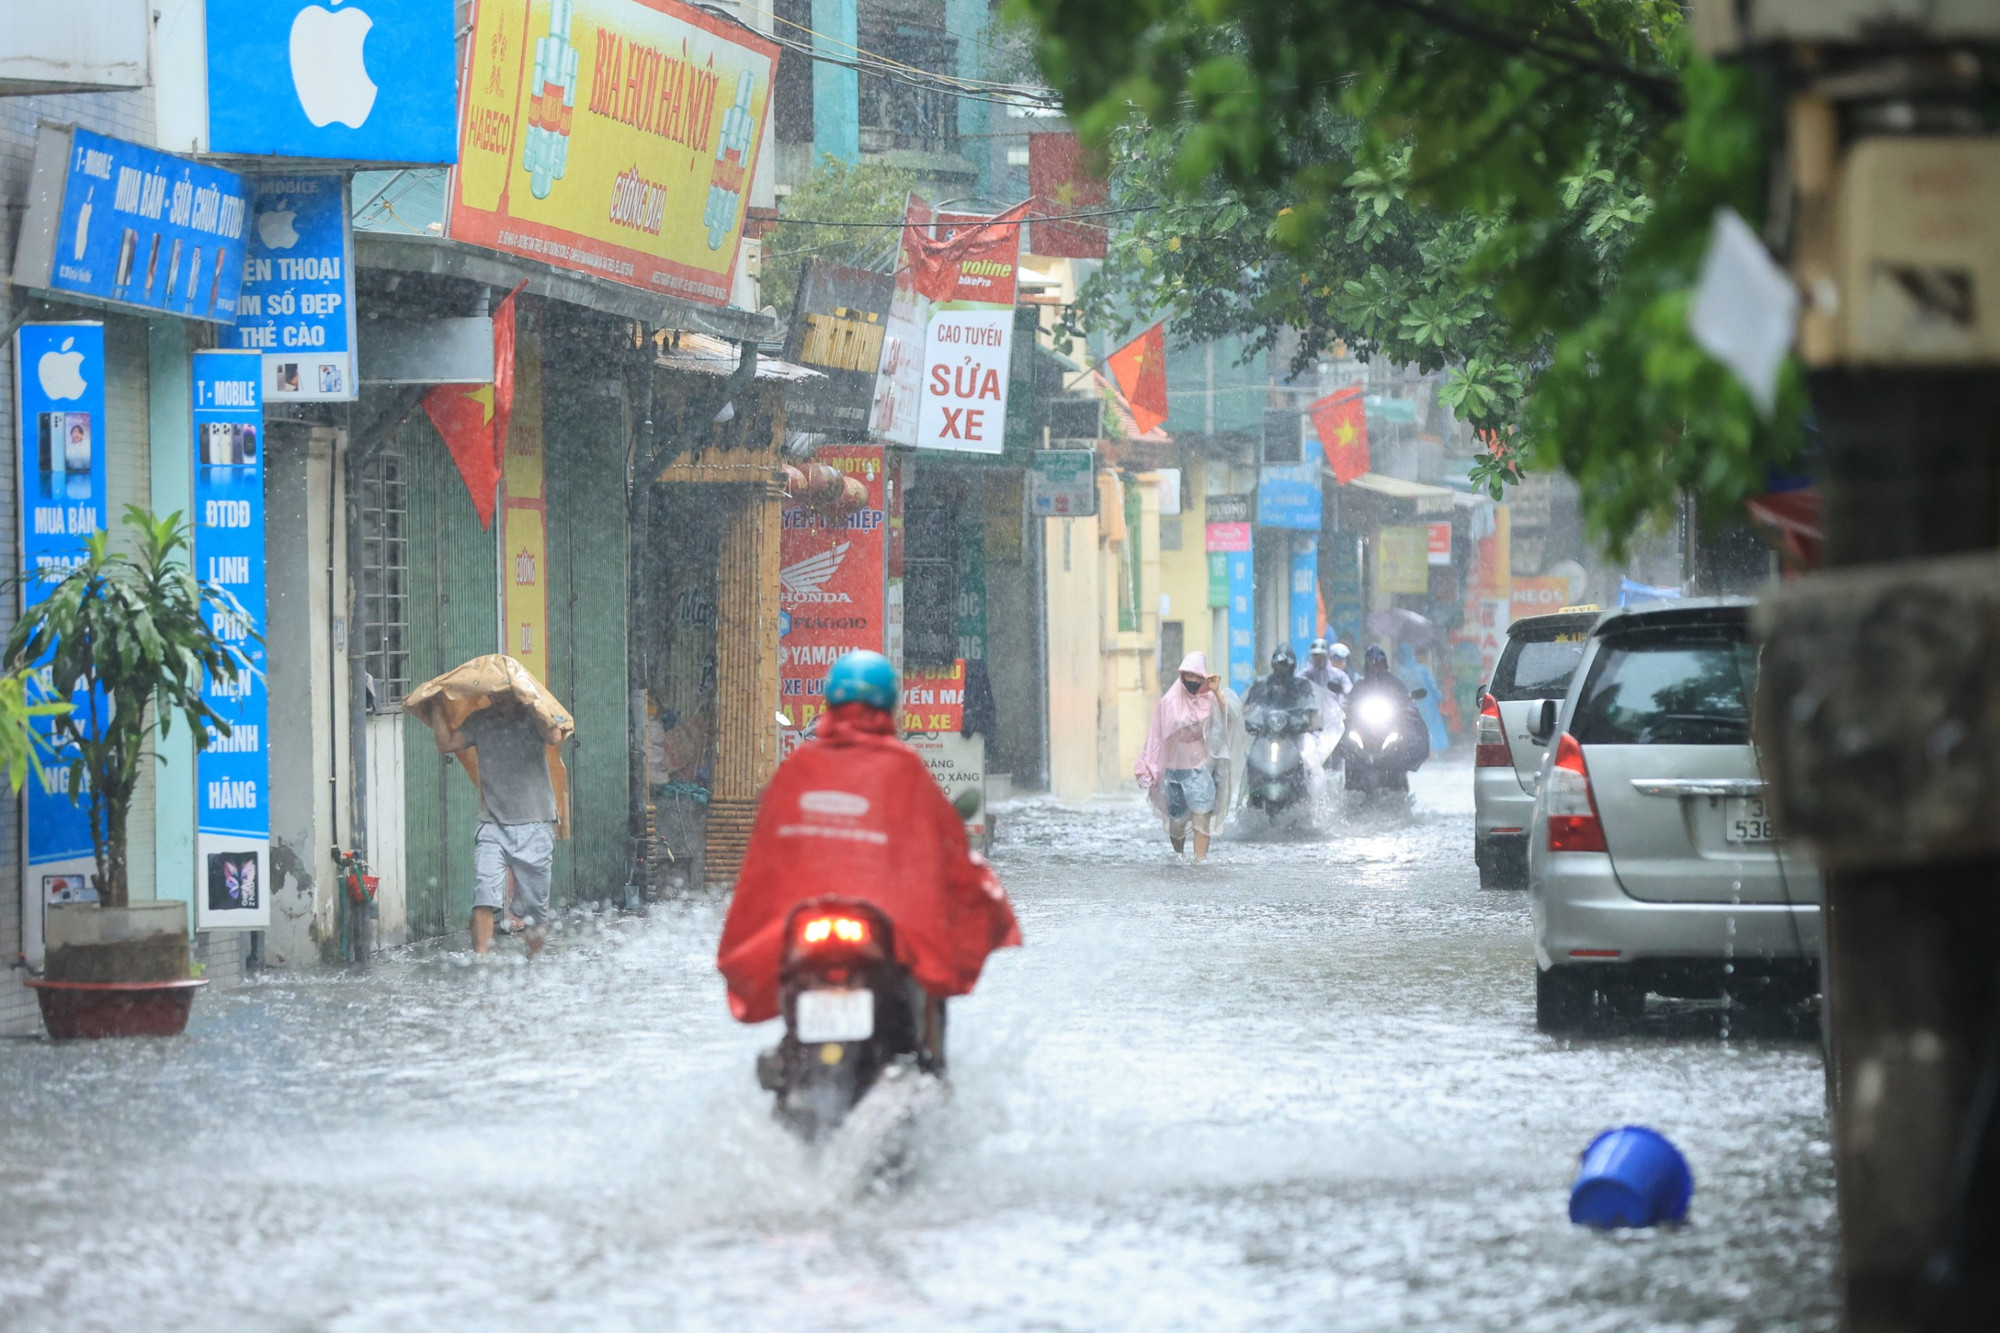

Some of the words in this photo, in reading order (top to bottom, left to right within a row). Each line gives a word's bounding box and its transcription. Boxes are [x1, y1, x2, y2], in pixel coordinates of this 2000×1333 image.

[589, 27, 623, 121] BIA
[654, 37, 687, 144] HÀ
[683, 50, 720, 172] NỘI
[468, 105, 511, 155] HABECO
[76, 146, 84, 172] T
[84, 149, 113, 180] MOBILE
[114, 166, 142, 214] MUA
[139, 165, 167, 220] BÁN
[609, 163, 650, 231] CƯỜNG
[643, 182, 667, 236] BIA
[243, 255, 272, 286] ỆN
[278, 257, 341, 285] THOẠI
[958, 275, 992, 288] bikePro
[961, 259, 1013, 278] voline
[236, 295, 262, 316] IM
[267, 287, 296, 316] SỐ
[301, 293, 342, 319] ĐẸP
[239, 320, 278, 347] THẺ
[283, 321, 325, 346] CÀO
[937, 324, 962, 343] CAO
[965, 322, 1003, 347] TUYẾN
[930, 355, 1001, 401] SỬA
[198, 381, 205, 405] T
[214, 381, 256, 406] MOBILE
[939, 406, 985, 441] XE
[35, 507, 65, 534] MUA
[68, 501, 97, 534] BÁN
[206, 500, 251, 528] ĐTDĐ
[209, 557, 249, 584] LINH
[779, 592, 853, 603] HONDA
[957, 585, 981, 618] ỐC
[1512, 589, 1564, 604] NEOS
[793, 617, 868, 629] PIAGGIO
[791, 646, 860, 666] YAMAH
[958, 635, 982, 661] NG
[784, 679, 802, 695] XE
[903, 685, 934, 705] YẾN
[940, 689, 965, 708] MẠ
[903, 710, 923, 729] ỬA
[928, 714, 952, 729] XE
[206, 719, 259, 753] CHÍNH
[44, 766, 92, 793] NGA
[208, 776, 257, 809] HÃNG
